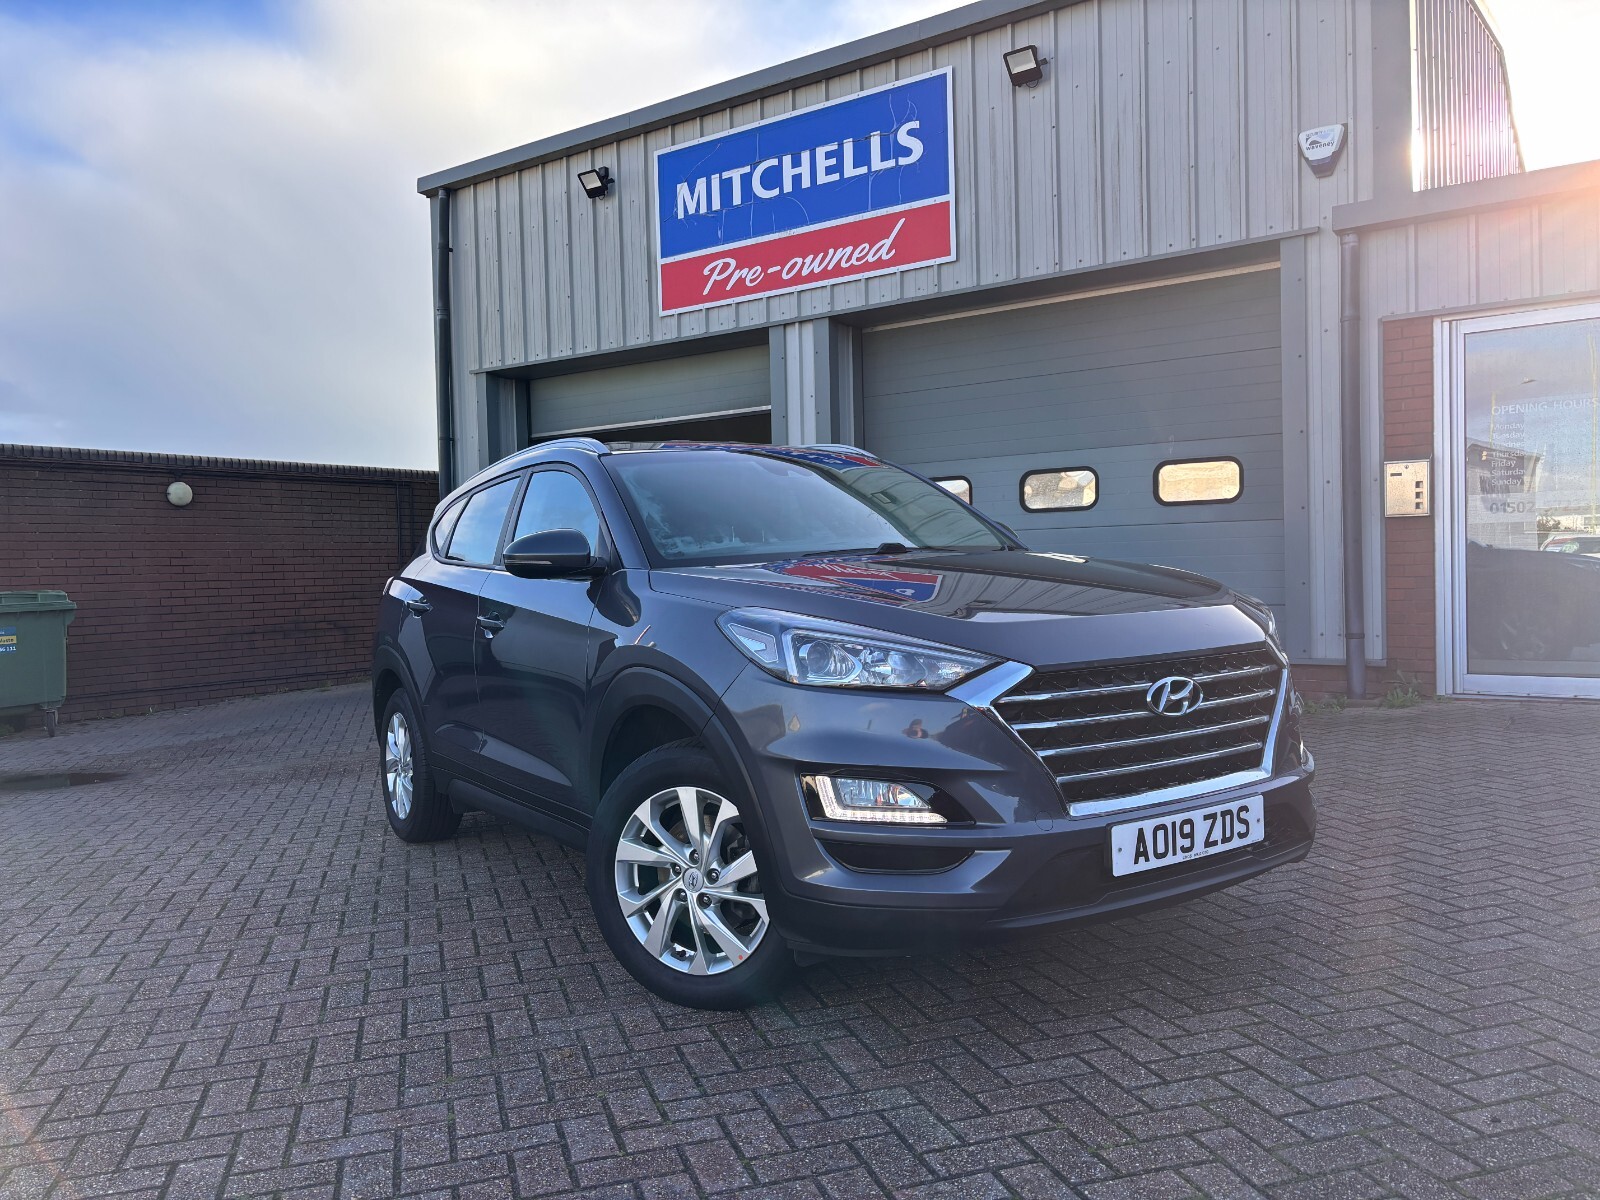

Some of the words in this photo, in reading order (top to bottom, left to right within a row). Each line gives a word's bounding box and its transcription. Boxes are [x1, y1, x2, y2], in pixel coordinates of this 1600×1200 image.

[1306, 141, 1335, 151] waveney
[677, 120, 923, 219] MITCHELLS
[703, 217, 905, 295] Pre-owned
[1491, 401, 1548, 416] OPENING
[1553, 397, 1600, 410] HOURS
[1491, 458, 1516, 468] Friday
[1491, 477, 1522, 487] Sunday
[1489, 501, 1536, 514] 01502
[1134, 818, 1195, 865] AO19
[1203, 805, 1250, 849] ZDS
